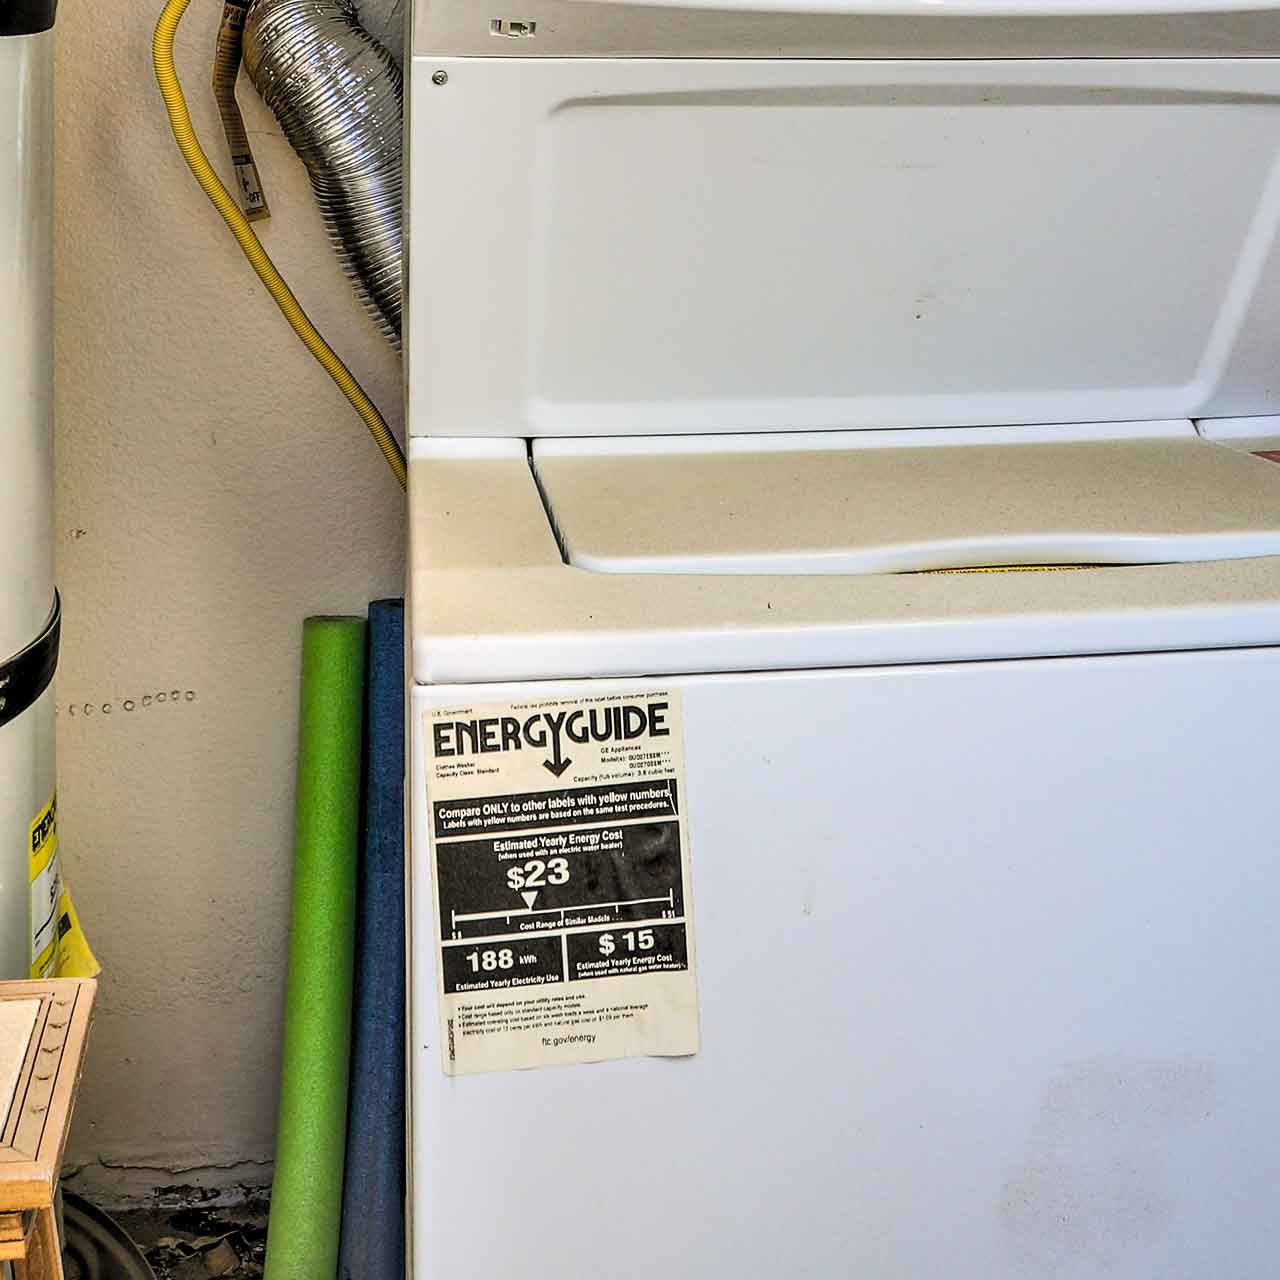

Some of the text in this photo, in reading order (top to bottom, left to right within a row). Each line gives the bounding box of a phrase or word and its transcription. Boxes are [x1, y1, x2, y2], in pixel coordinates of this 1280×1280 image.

[433, 703, 670, 757] ENERGYGUIDE
[439, 807, 481, 821] Compare
[483, 803, 509, 815] ONLY
[511, 803, 519, 813] to
[522, 800, 546, 811] other
[548, 795, 575, 809] labels
[577, 795, 597, 806] with
[599, 792, 627, 805] yellow
[443, 819, 466, 829] Labels
[468, 818, 481, 827] with
[483, 816, 505, 827] yellow
[507, 814, 537, 824] numbers
[551, 809, 571, 819] based
[583, 808, 594, 816] the
[615, 804, 627, 813] test
[493, 837, 538, 852] Estimated
[540, 835, 567, 850] Yearly
[569, 832, 600, 847] Energy
[602, 830, 623, 841] Cost
[507, 858, 570, 890] $23
[622, 930, 654, 951] 15
[466, 949, 514, 972] 188
[577, 954, 672, 970] Estimated Yearly Energy Cost
[456, 974, 559, 991] Estimated Yearly Electricity Use
[542, 1033, 596, 1047] ftc.gov/energy
